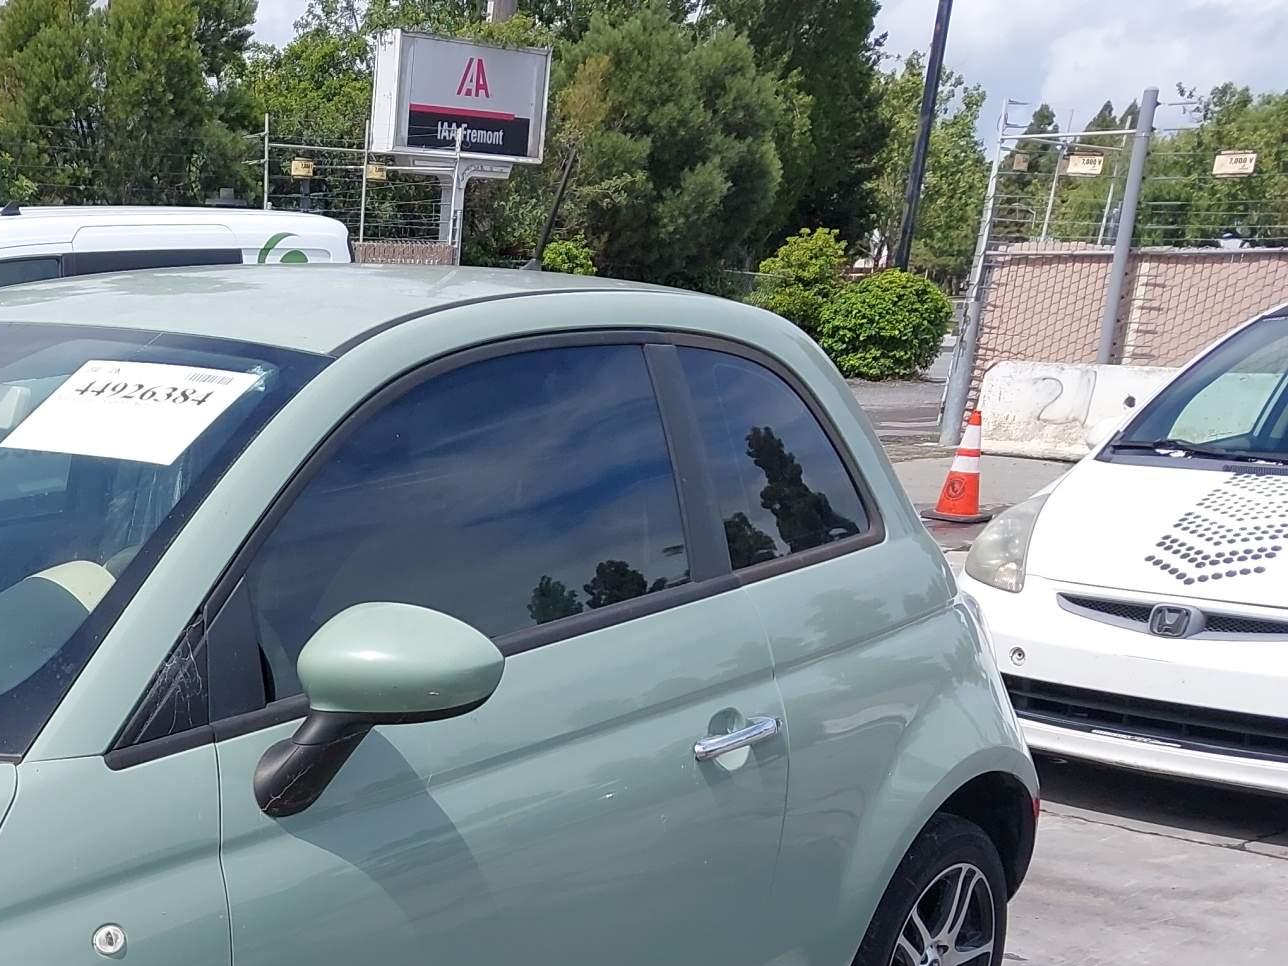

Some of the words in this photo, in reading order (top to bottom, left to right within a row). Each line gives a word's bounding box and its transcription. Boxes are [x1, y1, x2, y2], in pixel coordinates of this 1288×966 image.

[437, 121, 458, 140] IAA
[460, 123, 504, 145] Fremont
[75, 380, 215, 406] 44926384
